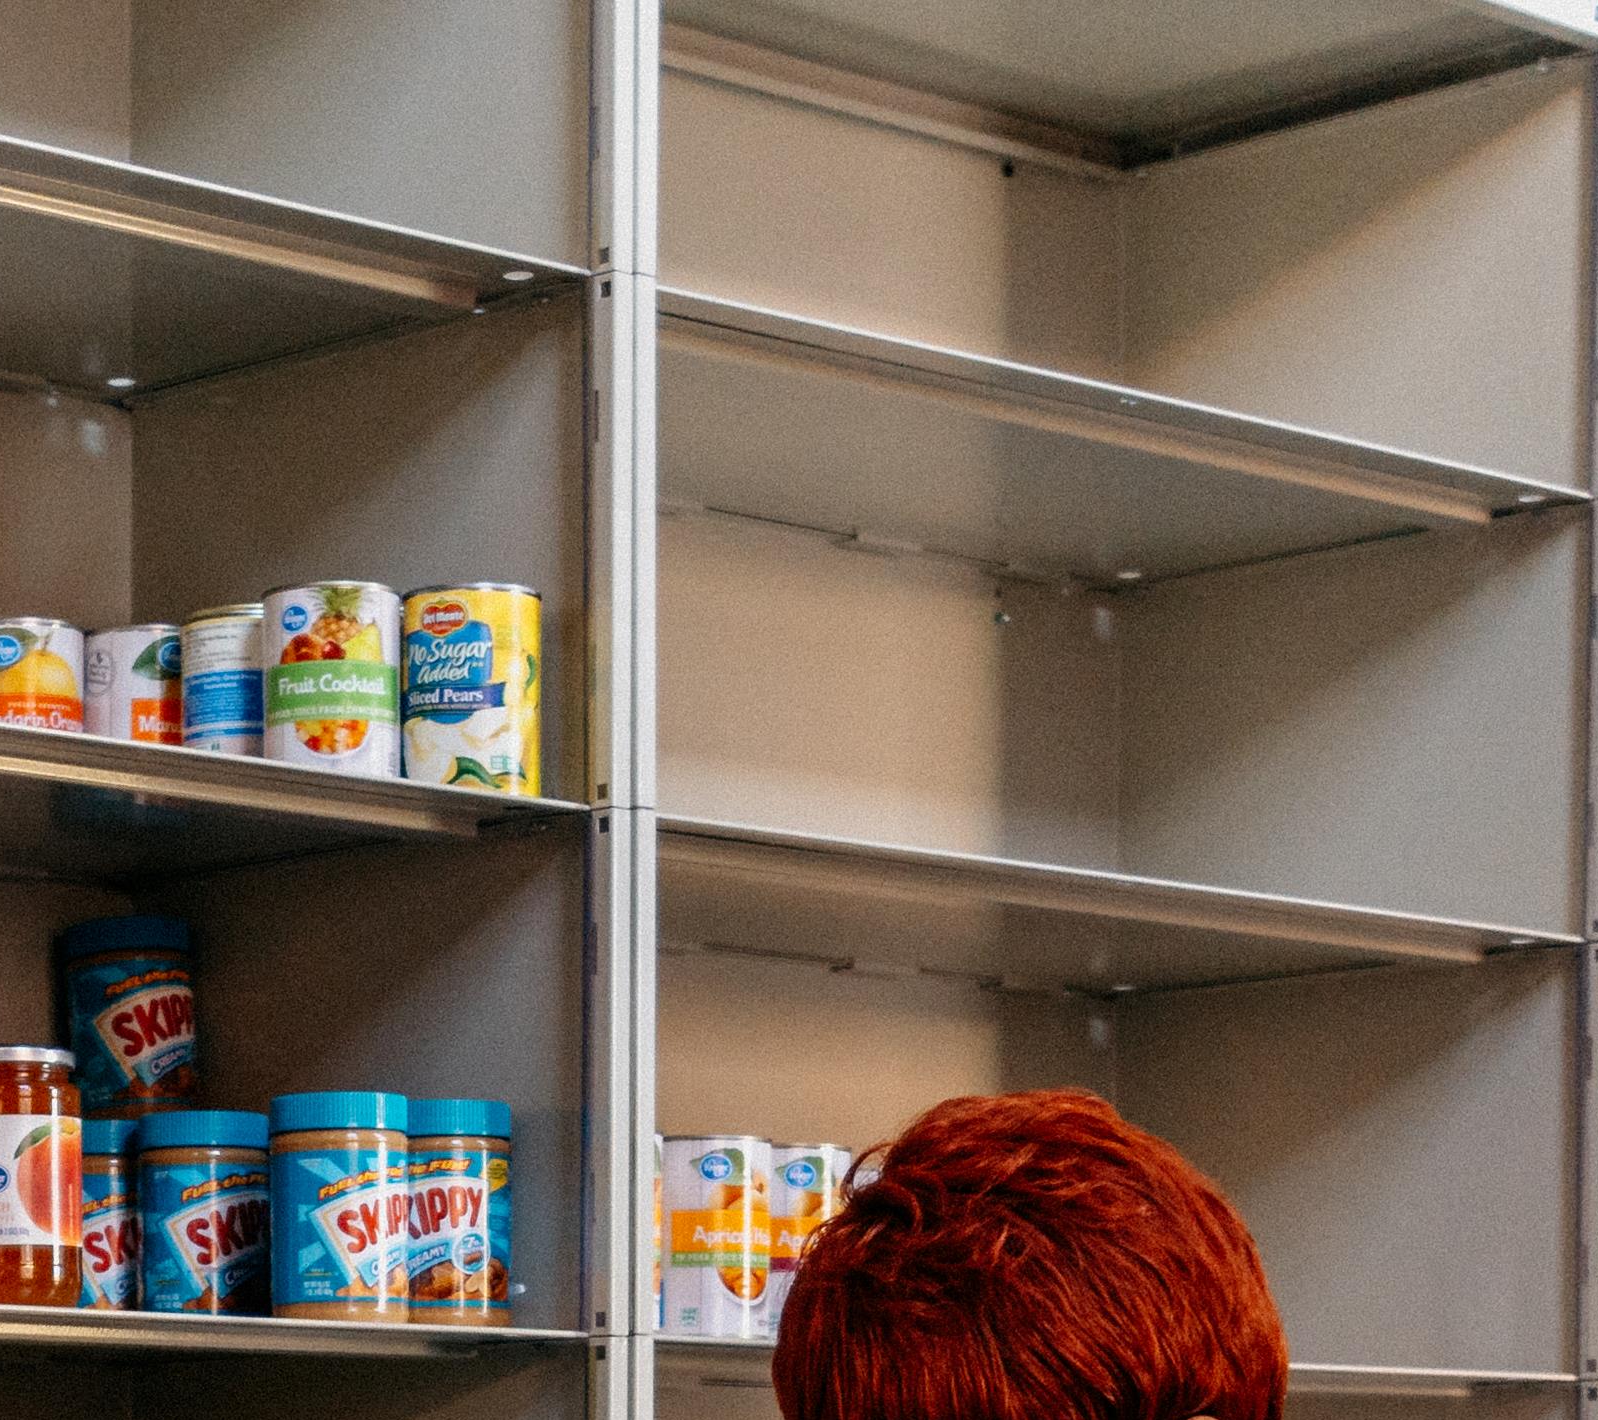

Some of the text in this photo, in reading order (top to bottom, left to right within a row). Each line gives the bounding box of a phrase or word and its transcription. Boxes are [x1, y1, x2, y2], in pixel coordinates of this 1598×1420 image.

[428, 640, 492, 663] Sugar
[418, 662, 469, 683] Added
[278, 674, 385, 694] Fruit Cocktail
[444, 690, 483, 702] Pears
